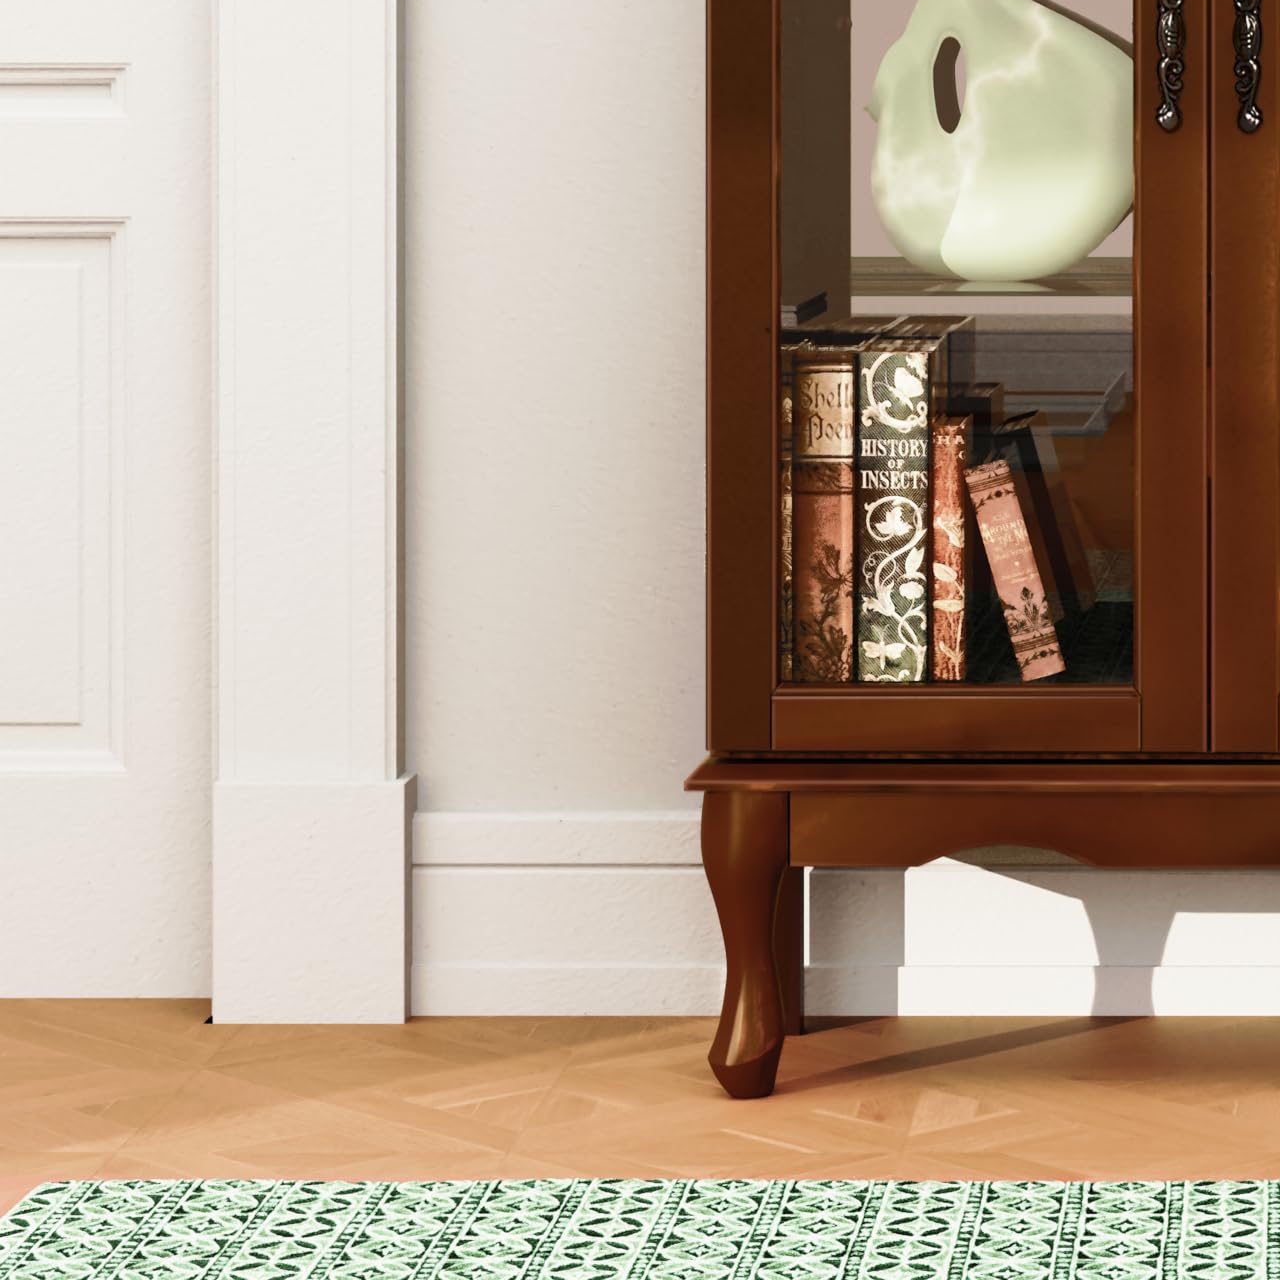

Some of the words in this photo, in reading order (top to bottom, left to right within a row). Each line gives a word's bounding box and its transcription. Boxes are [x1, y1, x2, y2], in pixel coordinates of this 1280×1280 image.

[800, 378, 853, 409] Shell
[860, 438, 928, 457] HISTORY
[887, 459, 905, 469] OF
[861, 470, 928, 489] INSECTS
